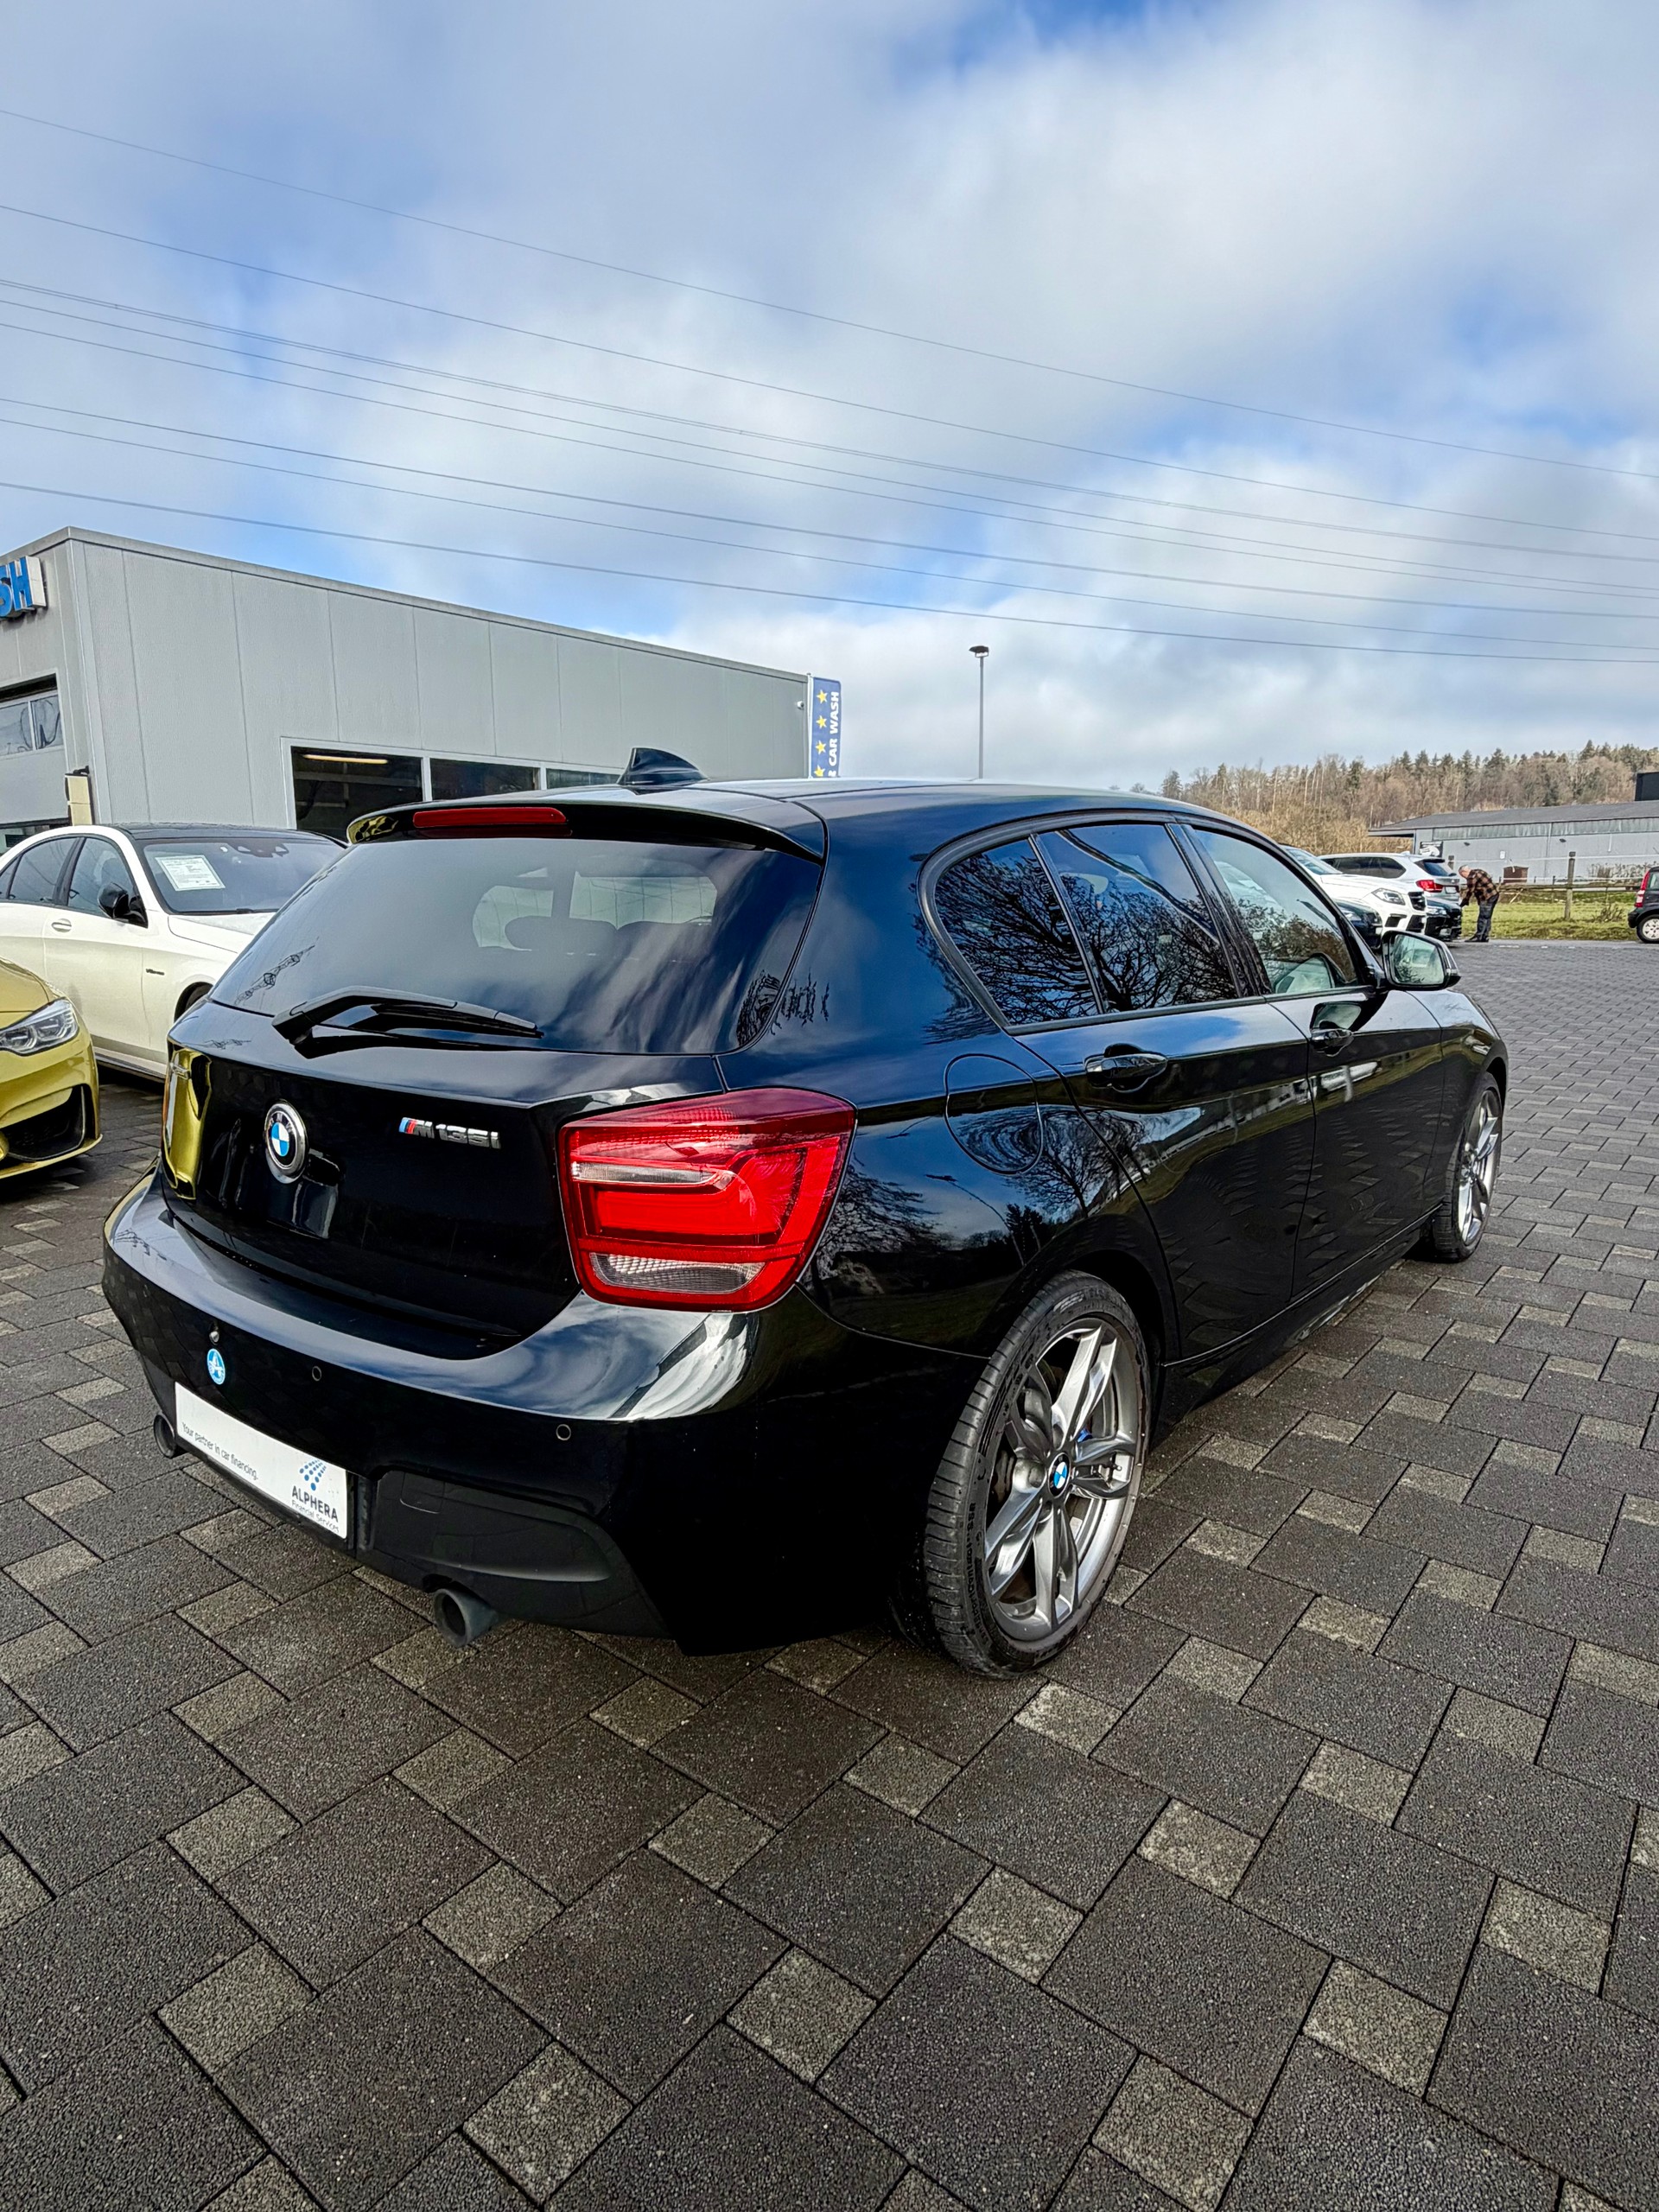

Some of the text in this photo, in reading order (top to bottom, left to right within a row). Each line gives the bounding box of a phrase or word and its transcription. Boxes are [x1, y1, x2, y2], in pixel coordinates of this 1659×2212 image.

[830, 691, 840, 734] WASH
[829, 738, 838, 766] CAR
[181, 1421, 194, 1438] Your
[214, 1442, 221, 1455] in
[221, 1449, 231, 1461] car
[292, 1484, 340, 1523] ALPHERA
